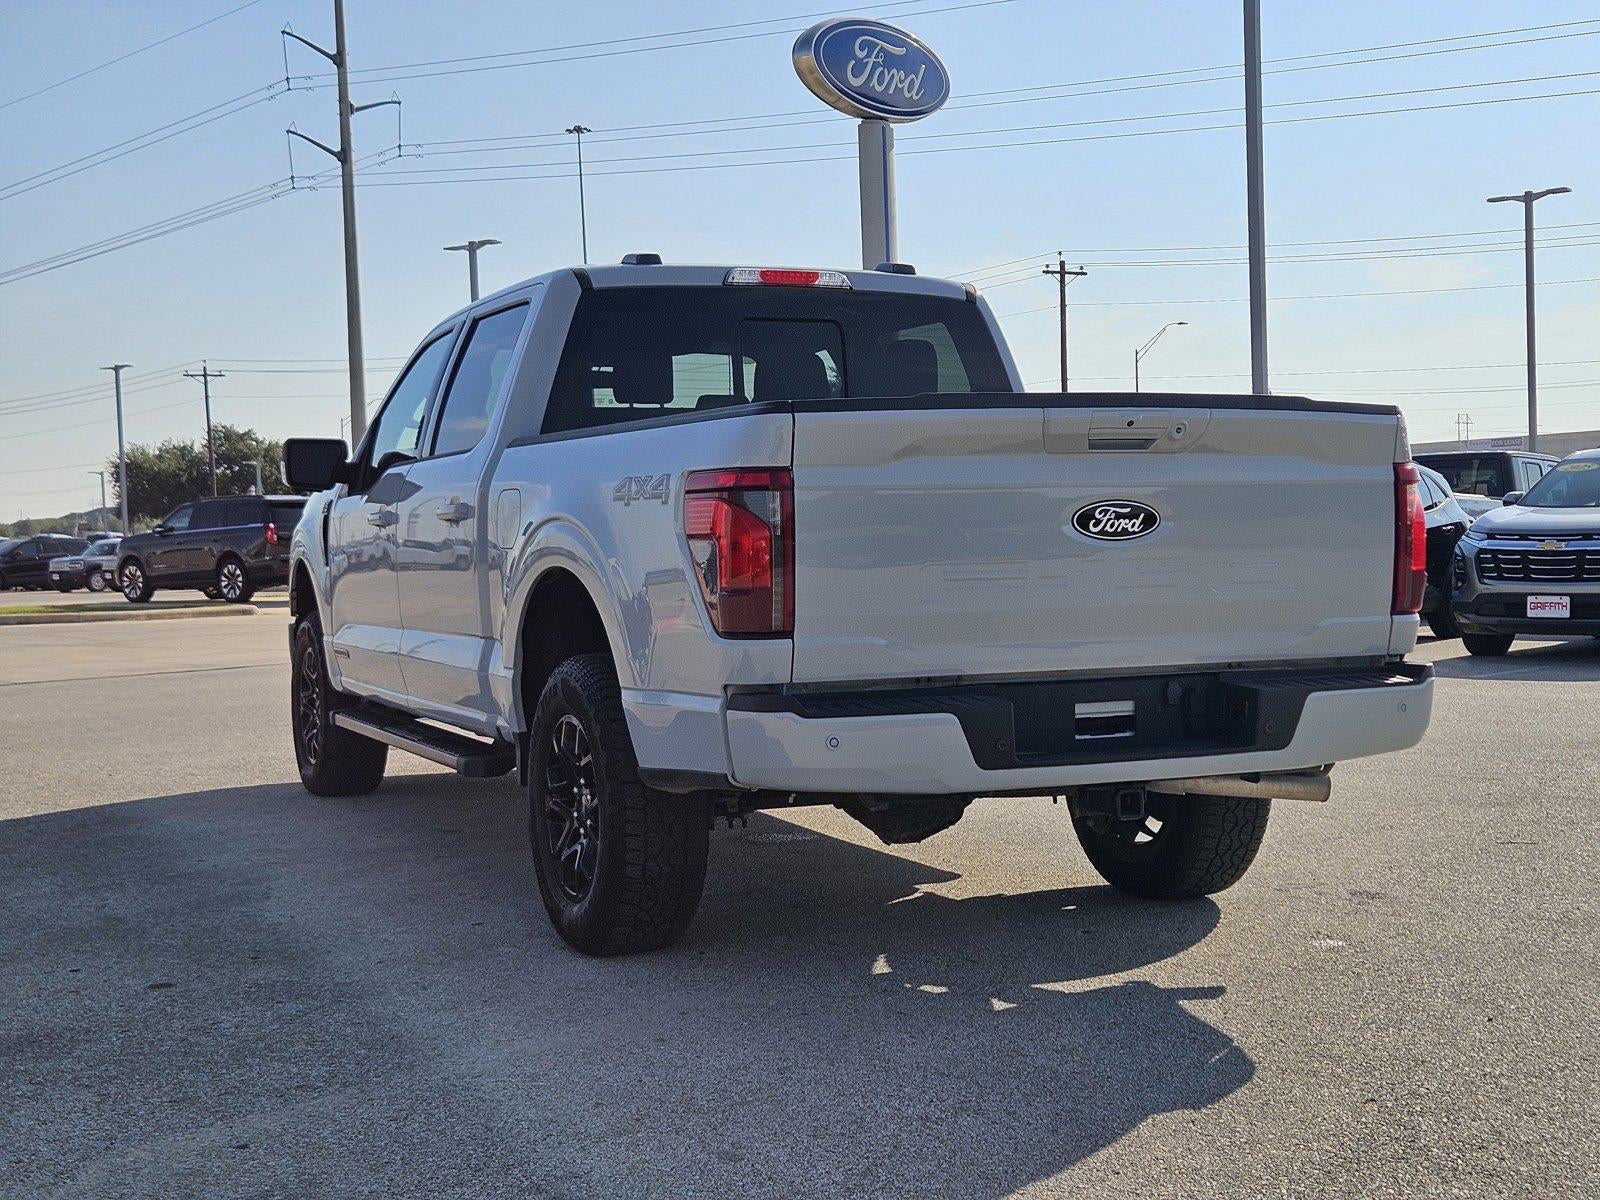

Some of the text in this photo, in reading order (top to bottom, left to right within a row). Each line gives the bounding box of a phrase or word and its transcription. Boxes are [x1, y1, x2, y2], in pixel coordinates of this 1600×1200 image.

[847, 35, 925, 100] Ford
[1088, 506, 1144, 533] Ford
[1530, 601, 1568, 611] GRIFFITH
